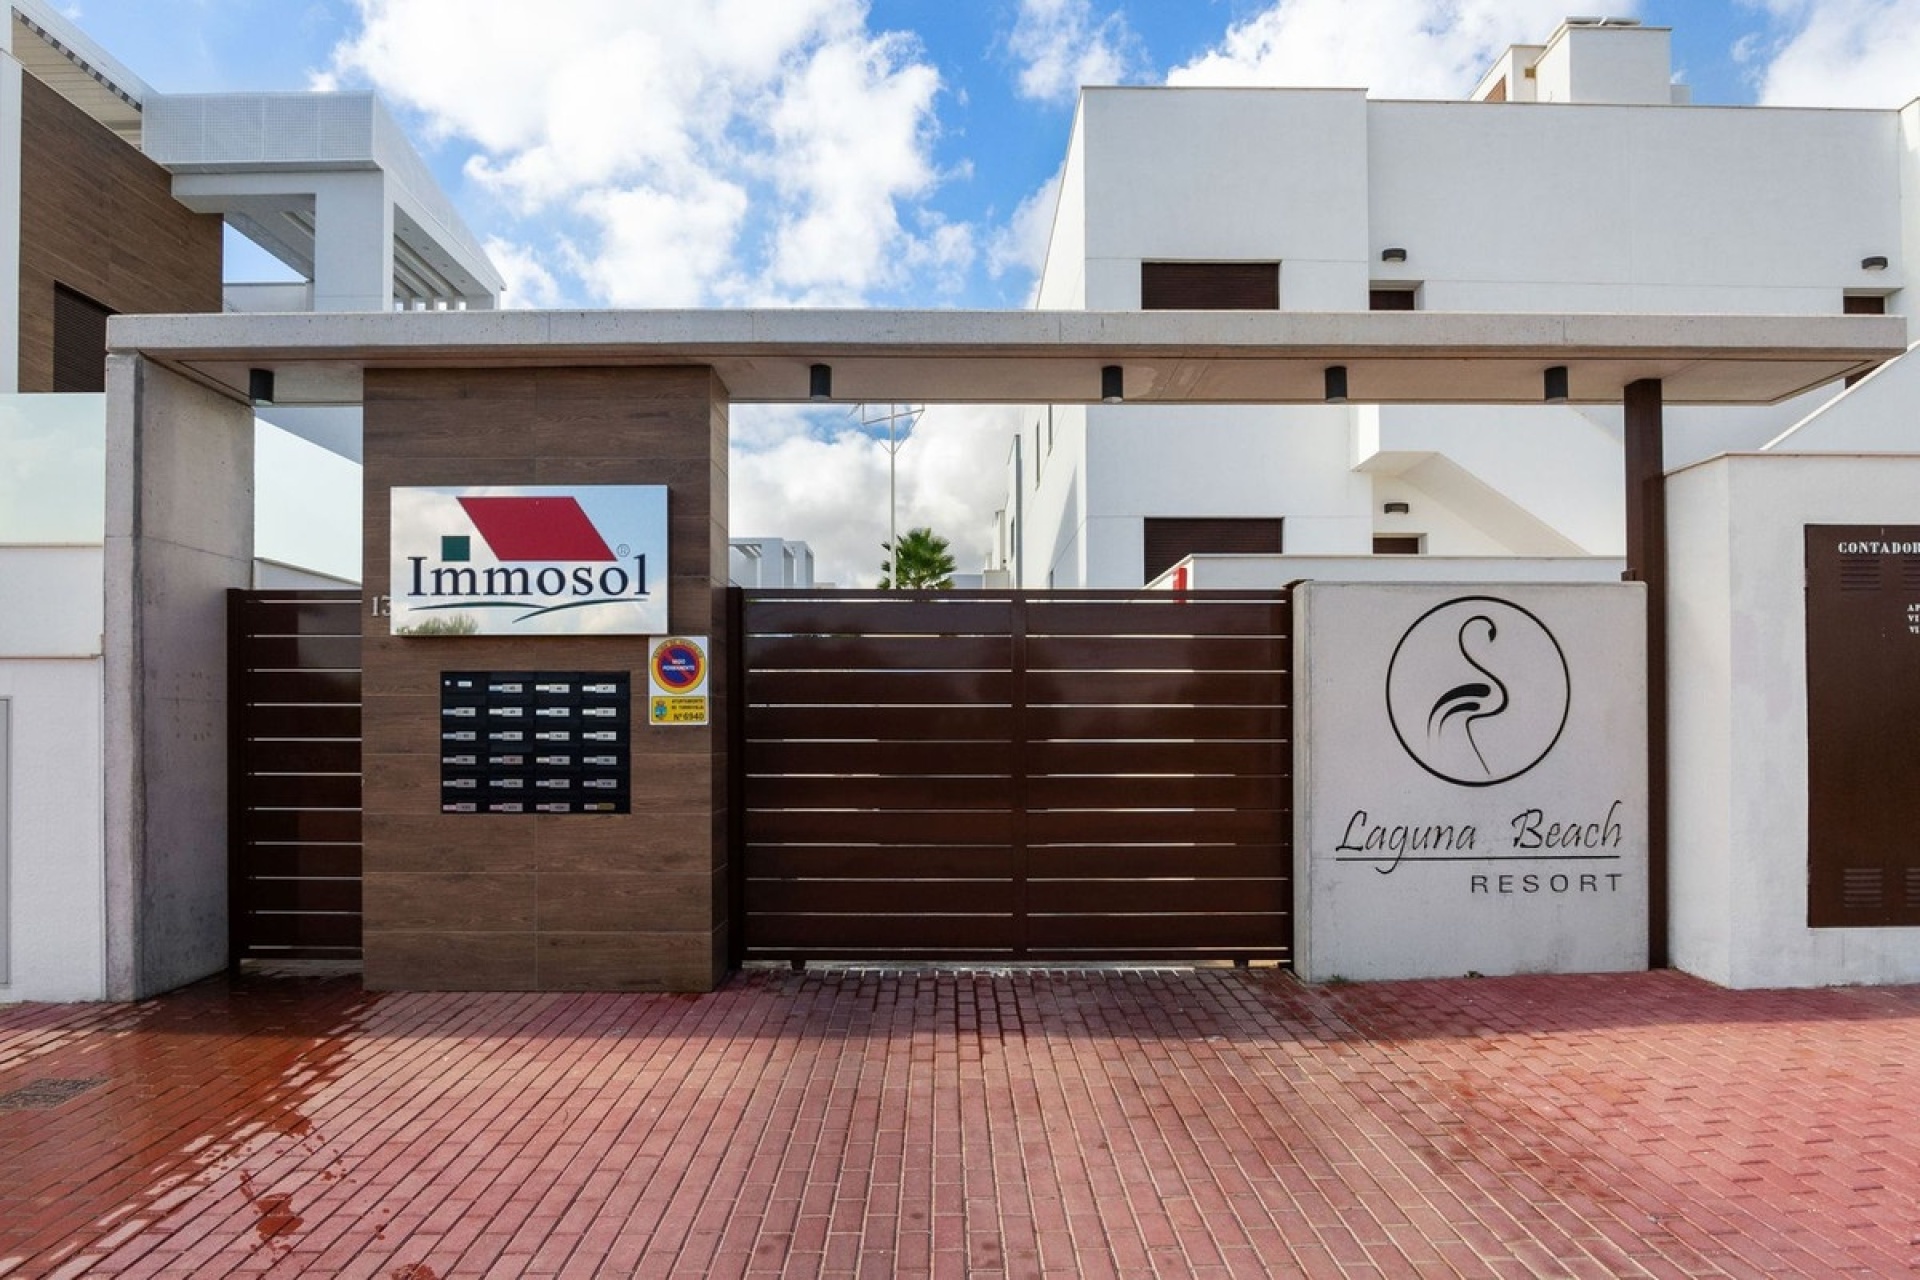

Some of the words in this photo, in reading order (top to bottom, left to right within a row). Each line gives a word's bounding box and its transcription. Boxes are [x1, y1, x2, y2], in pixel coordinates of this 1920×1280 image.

[407, 553, 651, 596] Immosol
[1335, 810, 1477, 875] Laguna
[1510, 799, 1624, 849] Beach
[1470, 873, 1623, 894] RESORT
